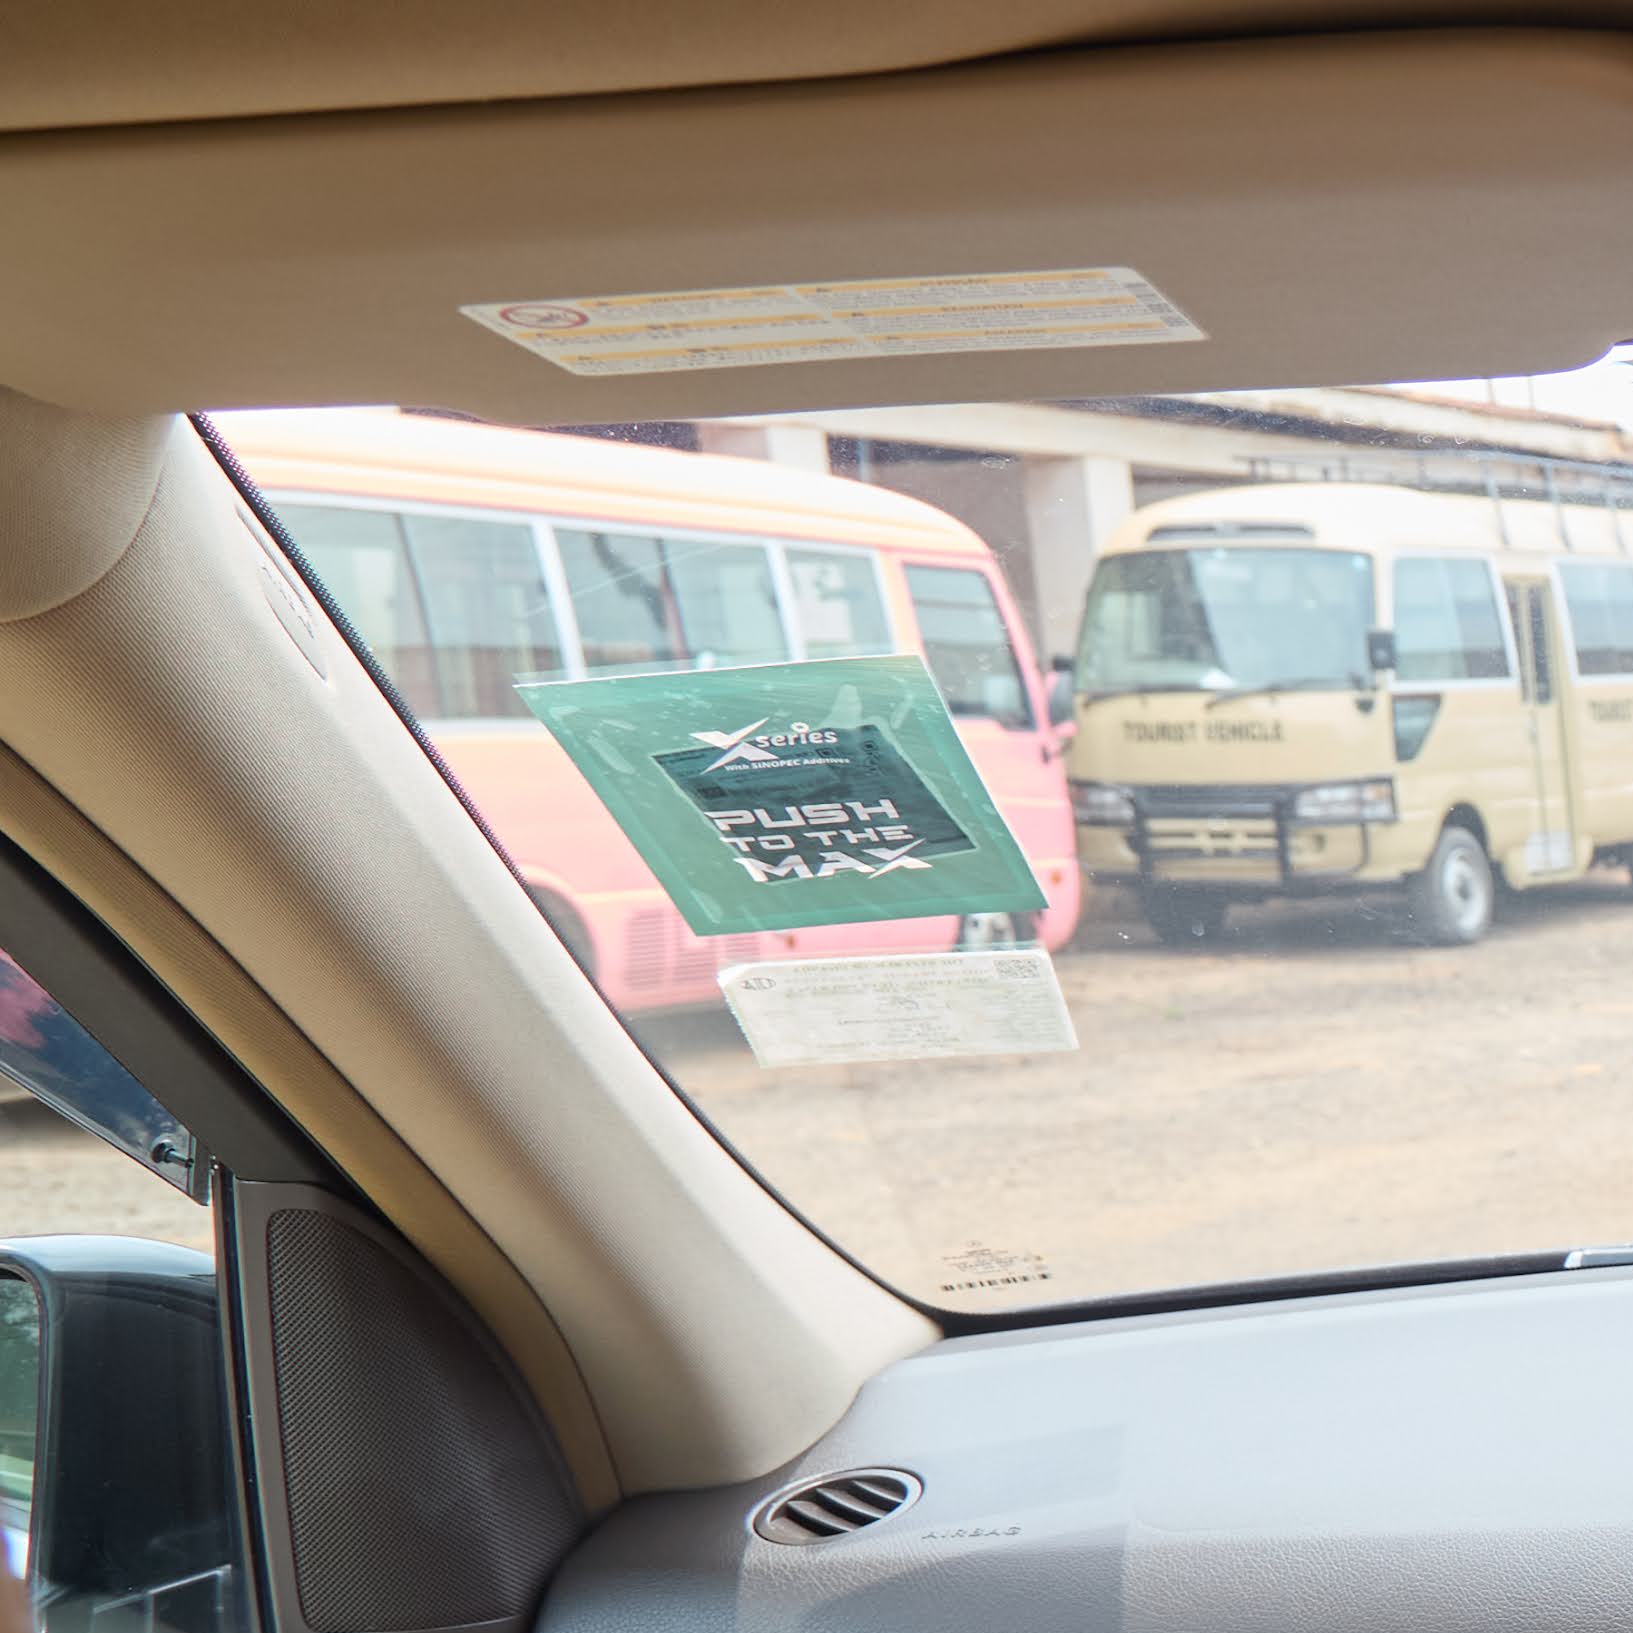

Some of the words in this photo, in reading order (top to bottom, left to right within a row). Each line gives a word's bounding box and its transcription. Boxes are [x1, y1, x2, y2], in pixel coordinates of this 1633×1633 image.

[754, 722, 839, 748] series
[724, 764, 749, 772] With
[751, 758, 801, 771] SINOPEC
[802, 757, 850, 767] Additives
[703, 798, 900, 832] PUSH
[720, 834, 795, 853] TO
[803, 824, 914, 847] THE
[732, 837, 933, 883] MAX
